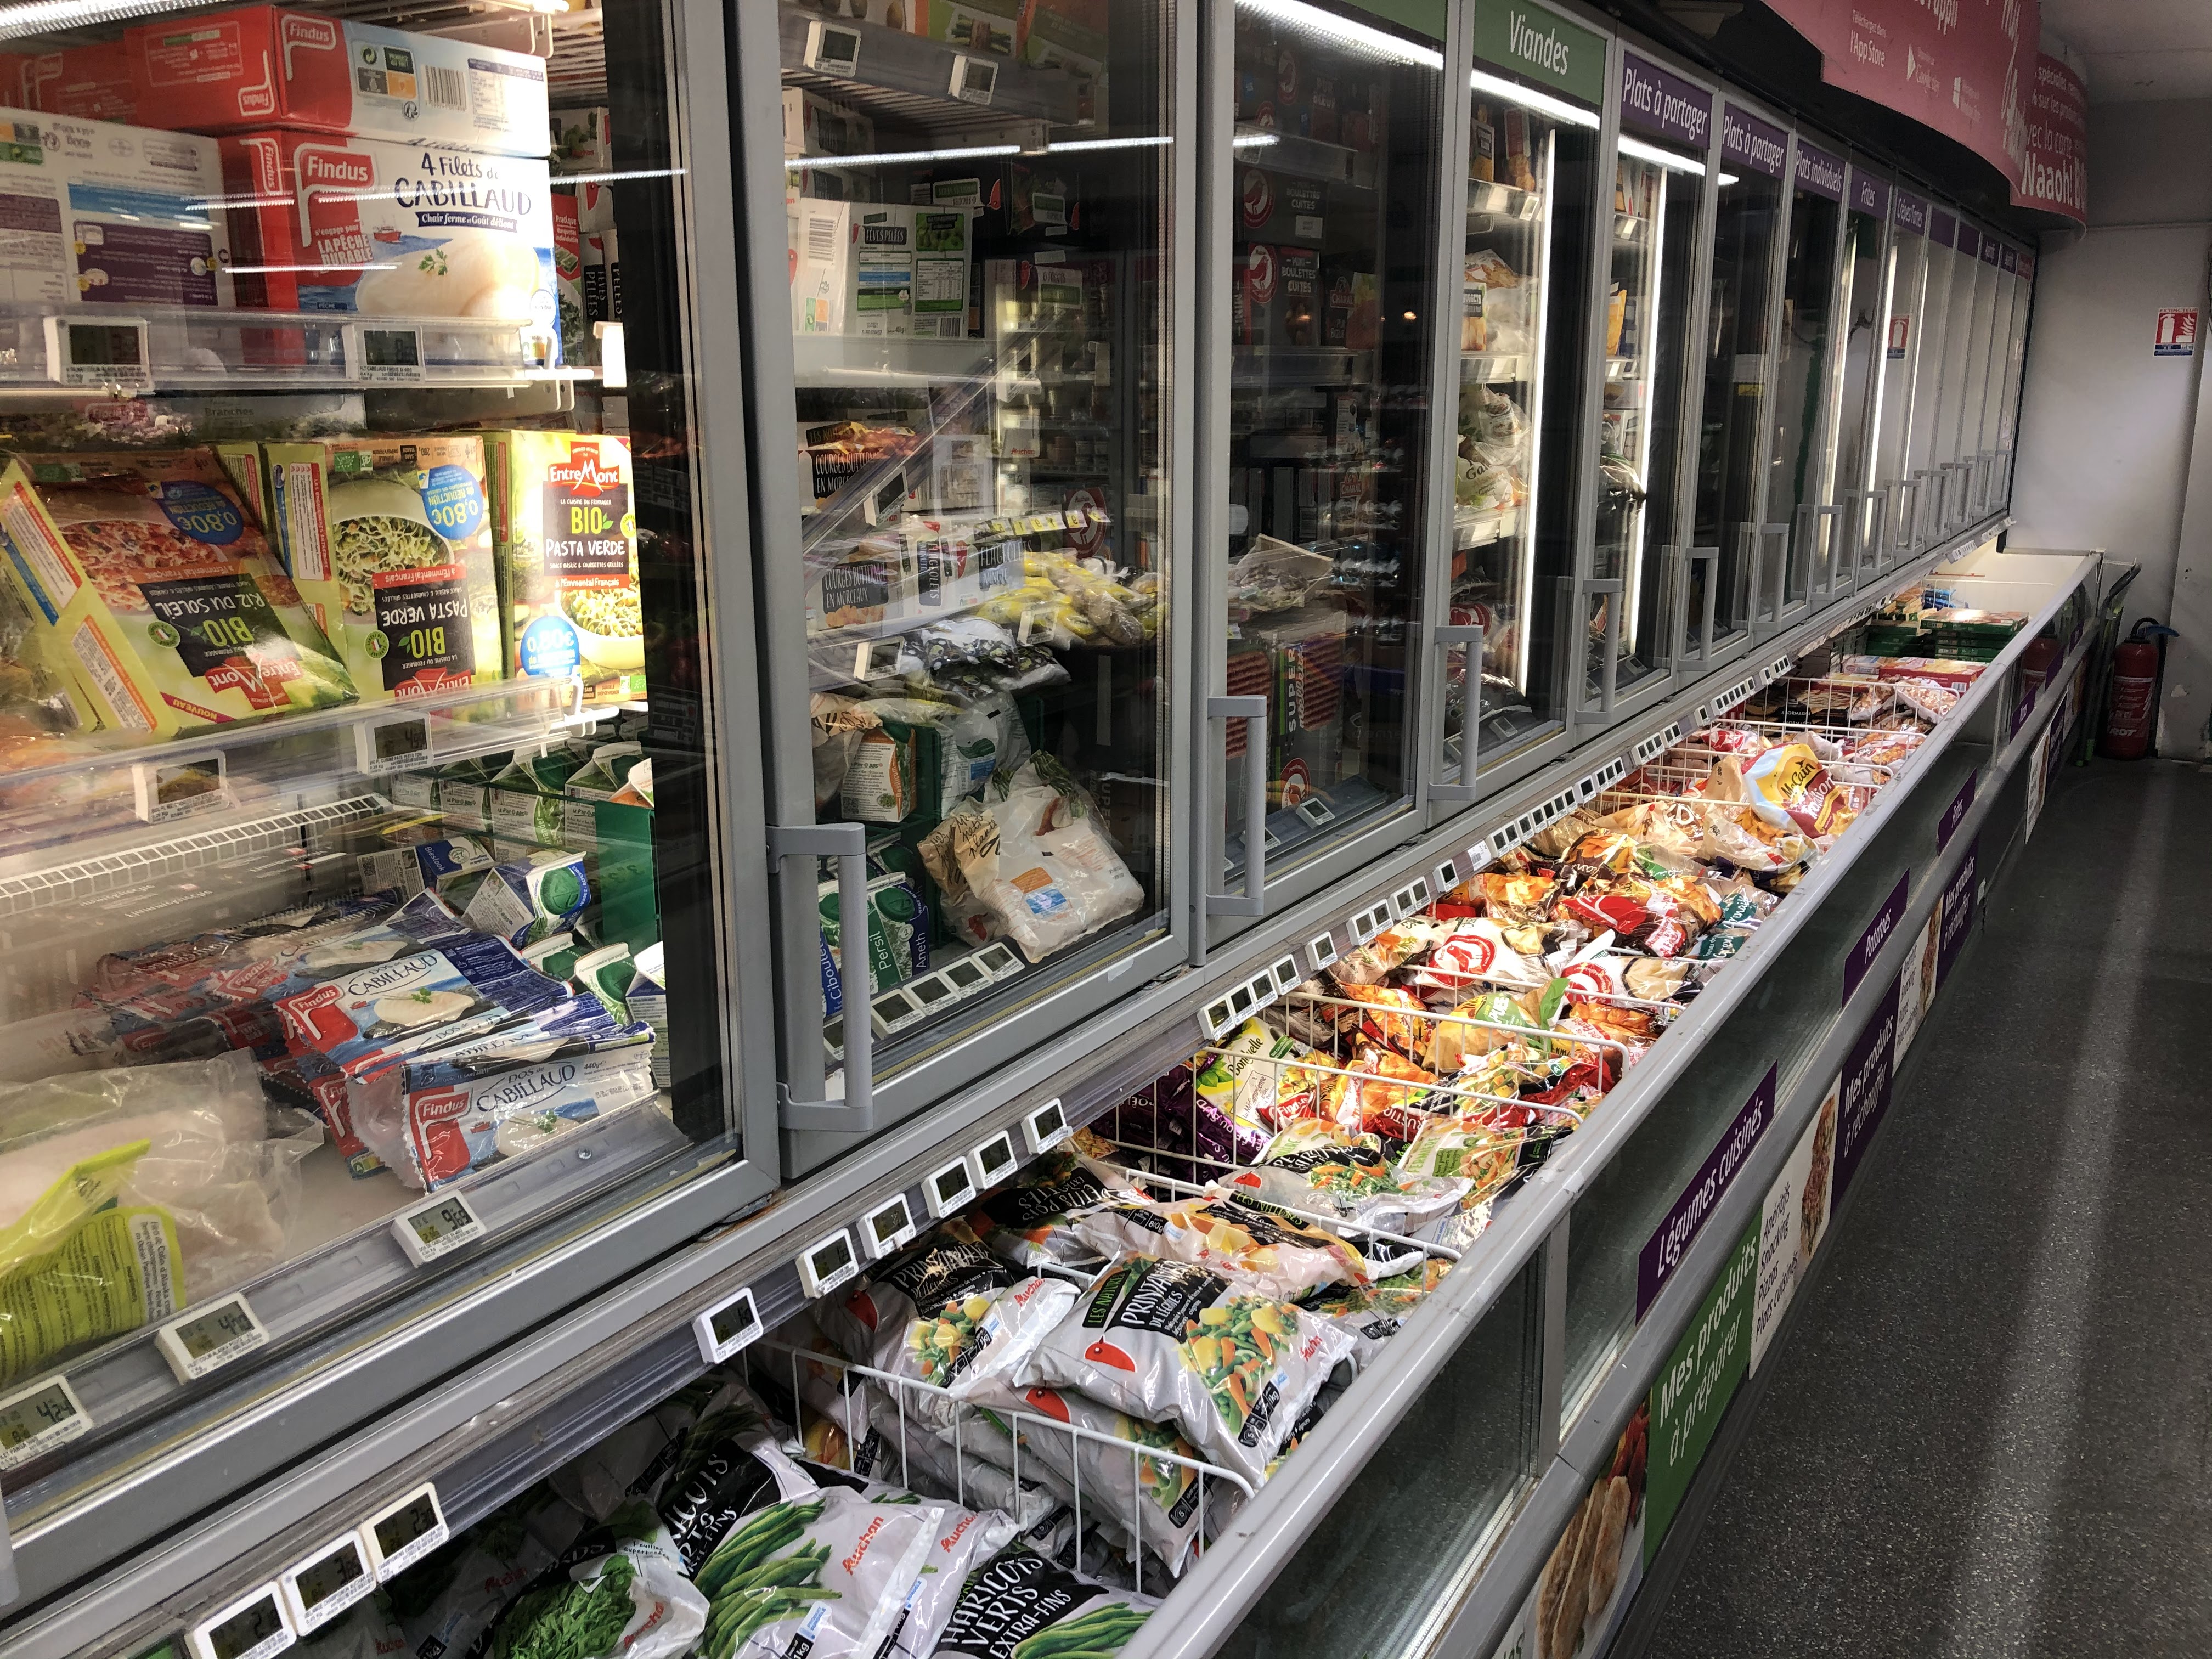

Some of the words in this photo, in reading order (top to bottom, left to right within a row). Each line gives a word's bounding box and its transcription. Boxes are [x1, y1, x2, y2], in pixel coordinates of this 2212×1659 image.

[289, 23, 330, 42] Findus
[1510, 10, 1569, 76] Viandes
[1867, 39, 1886, 67] Store
[241, 92, 269, 106] Findus
[1623, 67, 1652, 111] Plats
[1654, 80, 1661, 115] à
[1662, 92, 1708, 140] partager
[1722, 115, 1743, 152] Plats
[1745, 125, 1751, 154] à
[1751, 132, 1785, 174] partager
[263, 140, 276, 188] Findus
[307, 157, 369, 182] Findus
[421, 153, 436, 176] 4
[439, 156, 483, 178] Filets
[1795, 149, 1810, 180] Plats
[394, 178, 532, 216] CABILLAUD
[421, 213, 442, 224] Chair
[443, 213, 466, 227] ferme
[472, 215, 489, 227] Goût
[556, 215, 577, 226] Pratique
[317, 239, 334, 253] LA
[332, 234, 370, 252] PÊCHE
[321, 247, 374, 266] DURABLE
[1282, 267, 1317, 279] BOULETTES
[1288, 280, 1312, 293] CUITES
[550, 458, 618, 493] EntreMont
[817, 477, 827, 493] EN
[428, 488, 467, 505] RÉDUCTION
[432, 499, 478, 527] 0,80€
[571, 506, 602, 534] BIO
[546, 538, 584, 558] PASTA
[588, 539, 625, 556] VERDE
[980, 539, 1032, 567] FLAGEOLETS
[385, 571, 415, 583] Français
[416, 568, 450, 579] l'Emmental
[560, 578, 593, 588] l'Emmental
[595, 577, 620, 589] Français
[825, 567, 852, 590] COURGES
[428, 597, 467, 619] PASTA
[826, 595, 835, 607] EN
[837, 589, 869, 607] MORCEAUX
[381, 606, 425, 627] VERDE
[201, 616, 255, 647] BIO
[410, 626, 445, 658] BIO
[1288, 648, 1296, 733] SUPER
[173, 699, 218, 720] NOUVEAU
[1781, 762, 1816, 799] McCain
[425, 846, 445, 872] Bieslook
[869, 930, 891, 970] Persil
[916, 932, 927, 968] Aneth
[235, 960, 270, 986] Findus
[348, 953, 438, 996] CABILLAUD
[298, 989, 336, 1009] Findus
[435, 1025, 461, 1040] DOS
[508, 1070, 534, 1084] DOS
[584, 1062, 600, 1070] 440g
[1844, 1070, 1862, 1118] Mes
[1862, 1014, 1893, 1095] produits
[476, 1064, 576, 1113] CABILLAUD
[422, 1098, 465, 1117] Findus
[1277, 1097, 1310, 1117] Findus
[1657, 1166, 1718, 1279] Légumes
[1718, 1096, 1764, 1186] cuisinés
[1763, 1181, 1790, 1245] Apéritifs
[1759, 1212, 1790, 1278] Snacking
[1014, 1277, 1046, 1308] Auchan
[1756, 1299, 1773, 1342] Plats
[1774, 1251, 1798, 1308] cuisinés
[1758, 1260, 1779, 1310] Pizzas
[1087, 1308, 1103, 1324] LES
[1149, 1313, 1165, 1328] DE
[1660, 1343, 1695, 1427] Mes
[1697, 1234, 1757, 1374] produits
[1669, 1418, 1680, 1467] à
[1681, 1309, 1743, 1459] préparer
[842, 1515, 884, 1577] Auchan
[940, 1511, 979, 1553] Aucha
[941, 1554, 1043, 1644] HARICOTS
[962, 1584, 1038, 1646] VERTS
[989, 1588, 1072, 1659] EXTRA-FINS
